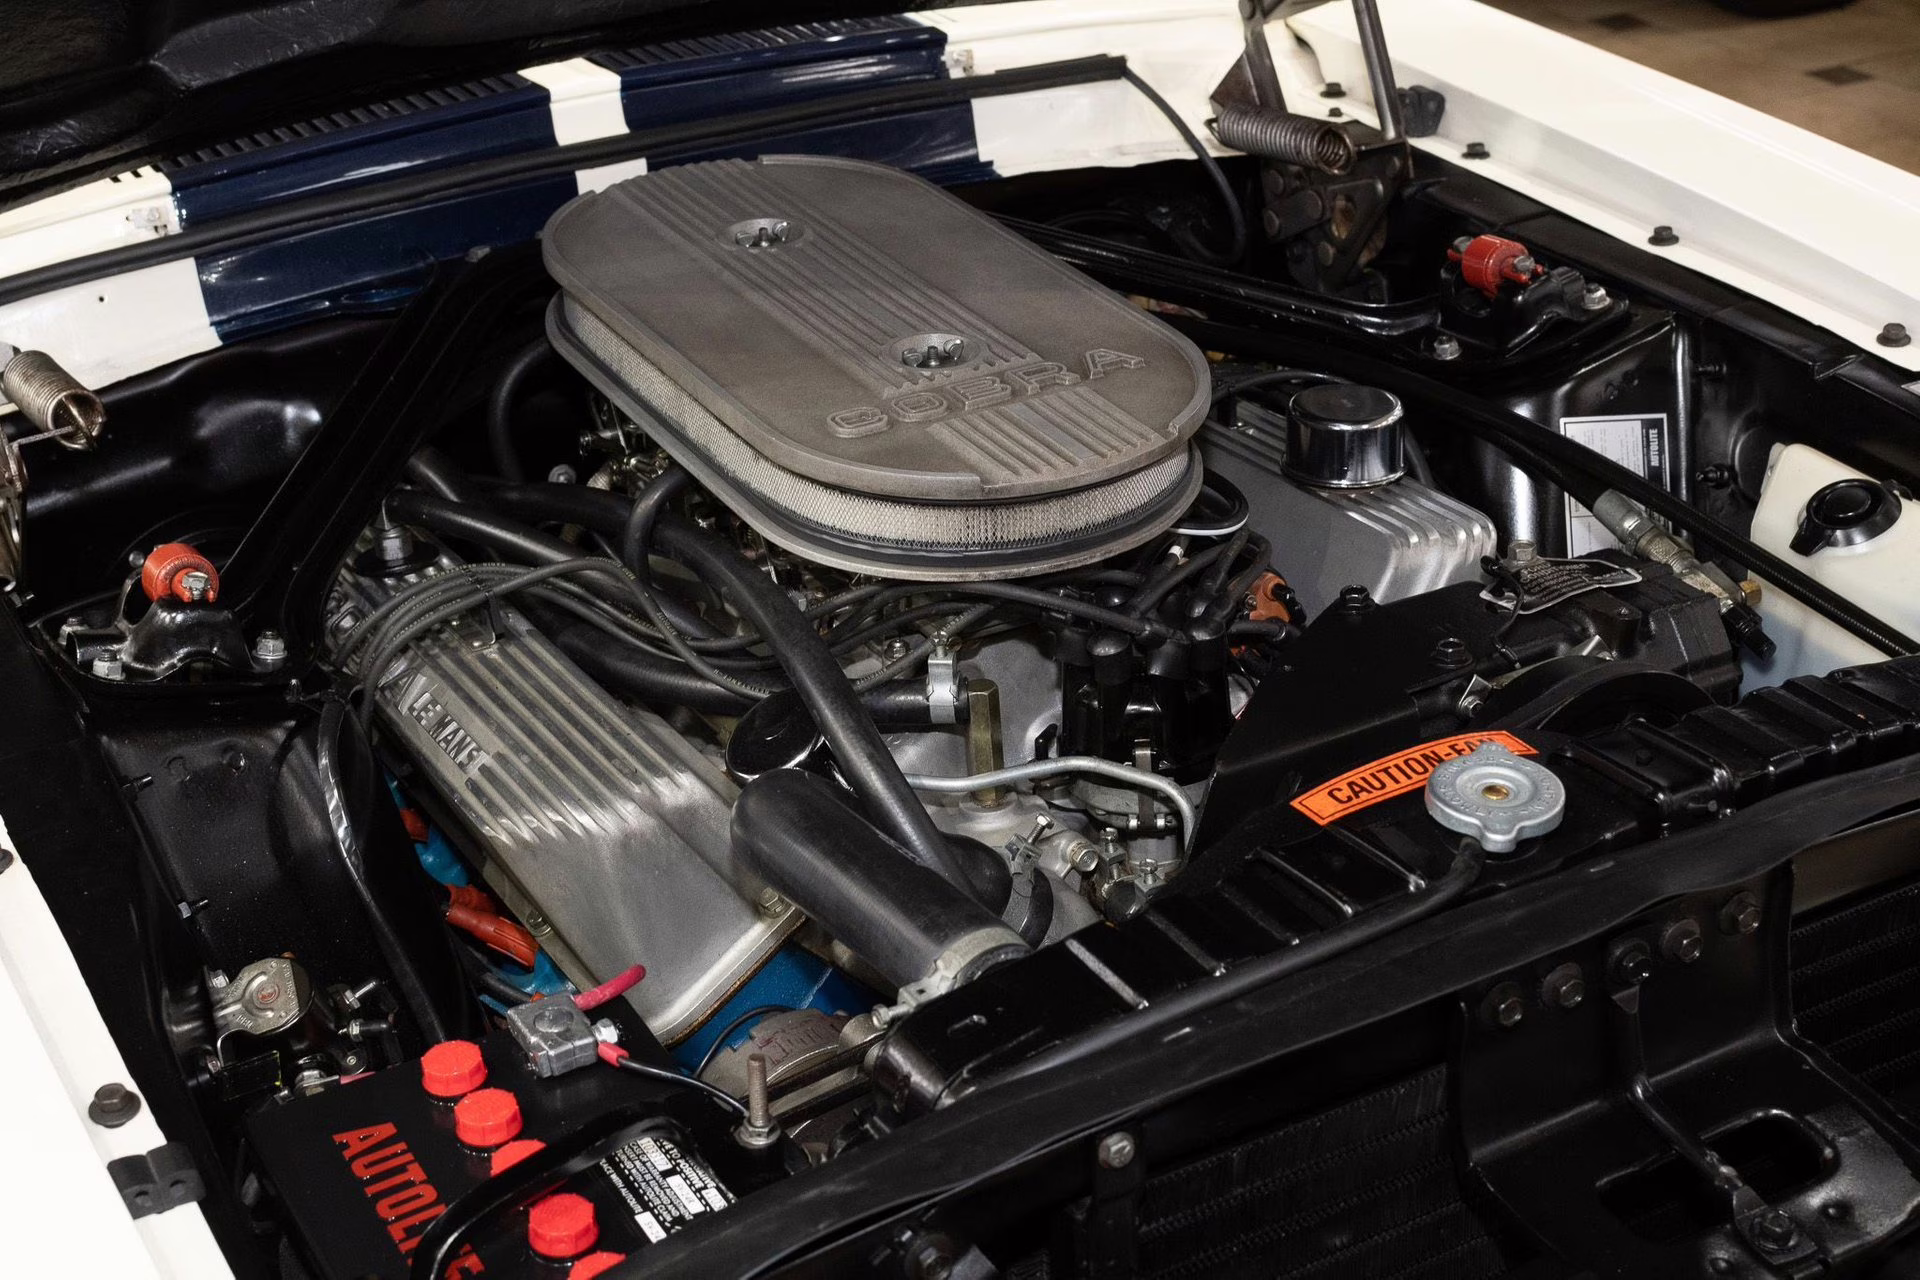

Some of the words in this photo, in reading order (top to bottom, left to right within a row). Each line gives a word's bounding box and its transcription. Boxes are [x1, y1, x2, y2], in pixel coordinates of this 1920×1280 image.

[827, 348, 1146, 438] COBRA
[1649, 428, 1660, 467] AUTOLITE
[412, 692, 443, 727] LE
[429, 714, 491, 775] MANS
[1327, 737, 1493, 805] CAUTION-FA
[631, 1142, 644, 1155] CASE
[640, 1154, 650, 1162] OF
[646, 1161, 670, 1188] WARRANTY
[665, 1187, 694, 1220] ADJUSTMENT
[670, 1149, 682, 1159] TO
[610, 1173, 625, 1188] WITH
[620, 1187, 643, 1213] AUTOLITE
[631, 1169, 644, 1182] WITH
[641, 1182, 662, 1205] AUTOLITE
[658, 1205, 673, 1221] CLAIM
[635, 1160, 649, 1174] MUST
[650, 1180, 672, 1204] REMOVED
[667, 1204, 681, 1217] AND
